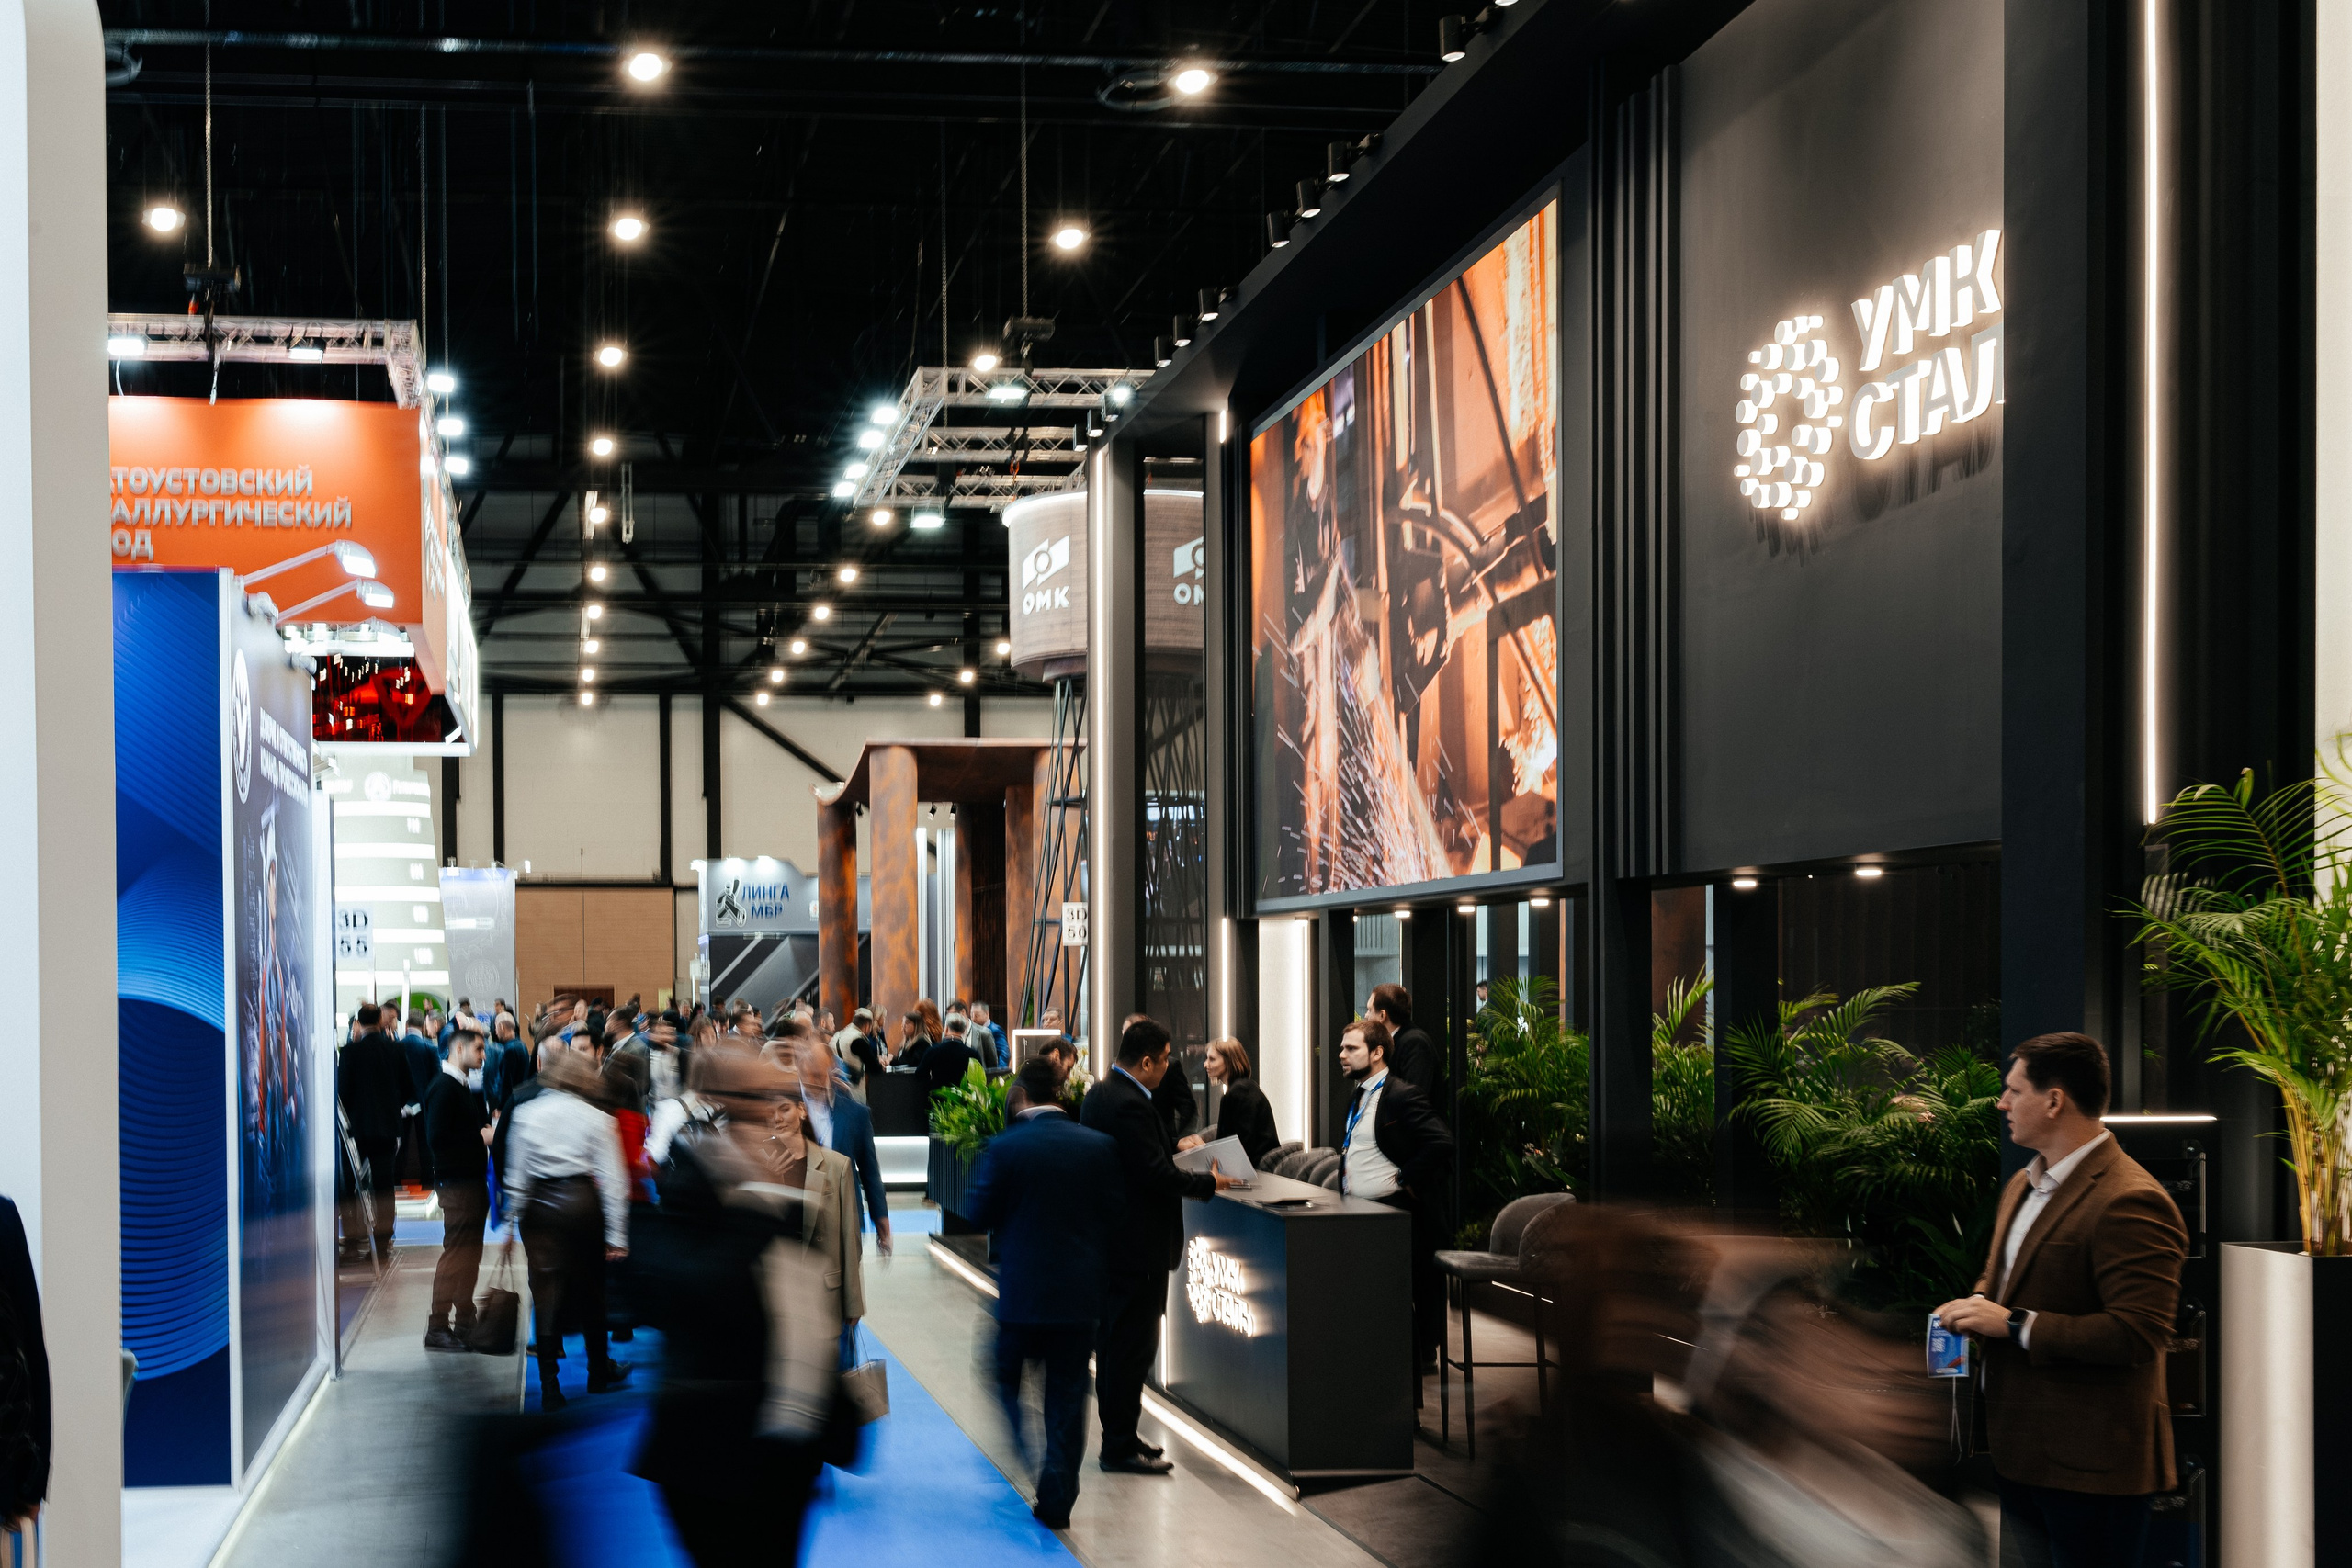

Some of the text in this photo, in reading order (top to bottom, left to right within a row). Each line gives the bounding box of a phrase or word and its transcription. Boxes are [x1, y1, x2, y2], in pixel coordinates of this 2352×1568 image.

[1850, 230, 2003, 371] УМК
[1849, 321, 2005, 460] СТАЛ
[110, 464, 312, 497] ТОУСТОВСКИЙ
[110, 496, 351, 528] АЛЛУРГИЧЕСКИЙ
[112, 529, 153, 561] ОД
[1023, 585, 1070, 615] ОМК
[742, 883, 790, 901] ЛИНГА
[337, 908, 368, 931] 3D
[1067, 908, 1088, 922] 3D
[1068, 925, 1087, 940] 50
